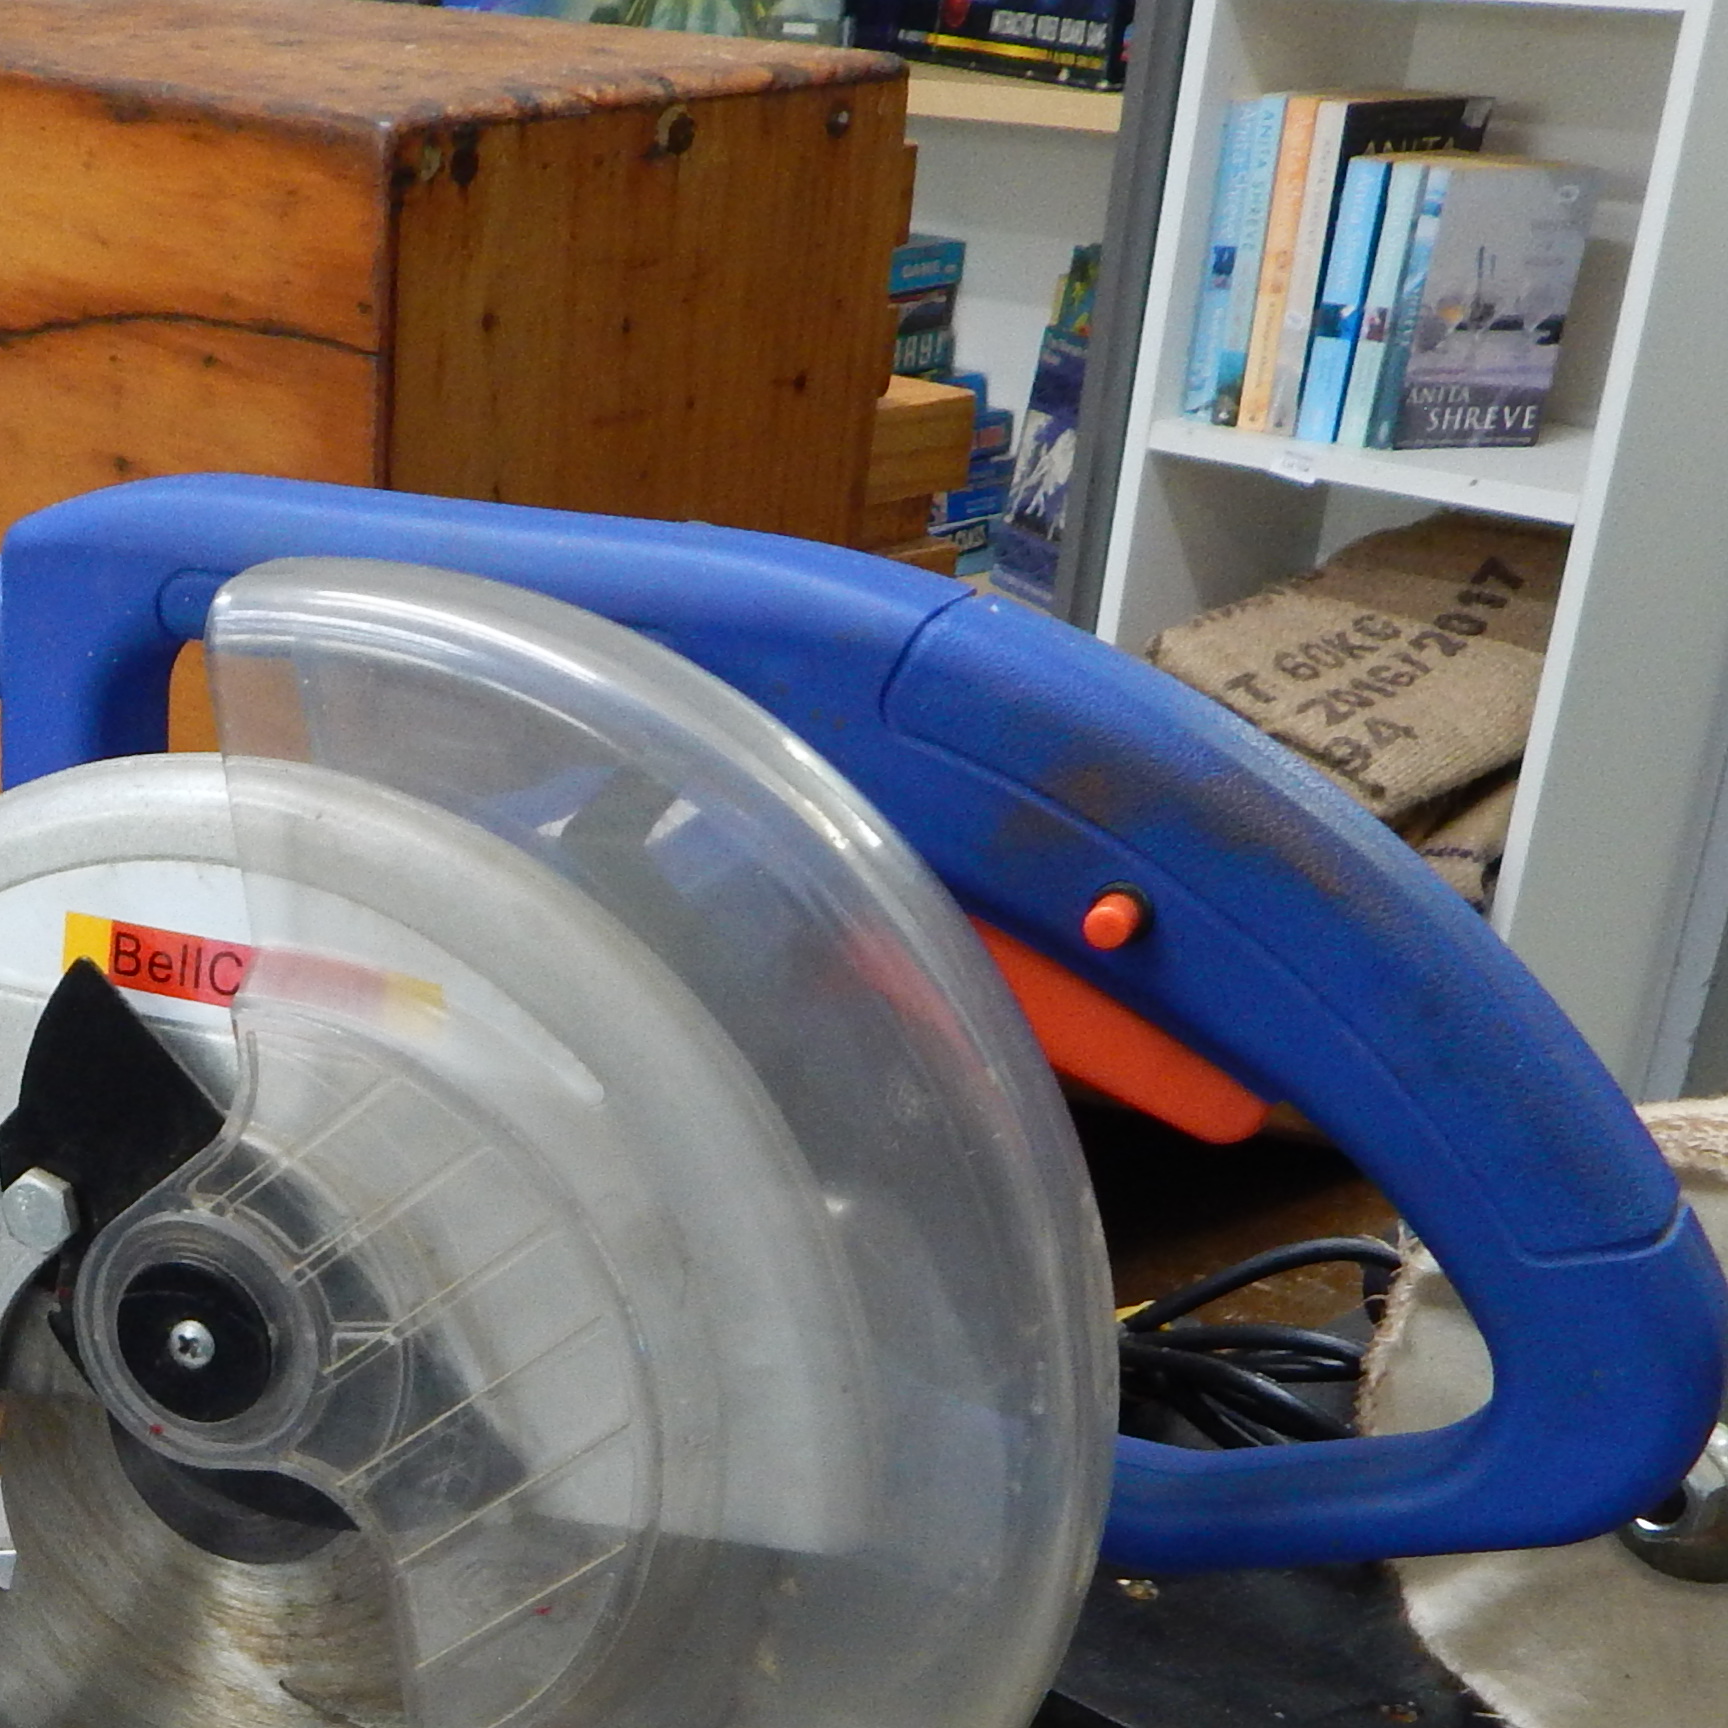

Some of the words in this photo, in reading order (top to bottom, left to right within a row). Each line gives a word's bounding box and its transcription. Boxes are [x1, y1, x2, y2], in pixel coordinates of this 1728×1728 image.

[1405, 383, 1471, 405] ANITA
[1425, 404, 1540, 433] SHREVE
[1274, 613, 1402, 682] 60KG
[1295, 556, 1525, 727] 2016/2017
